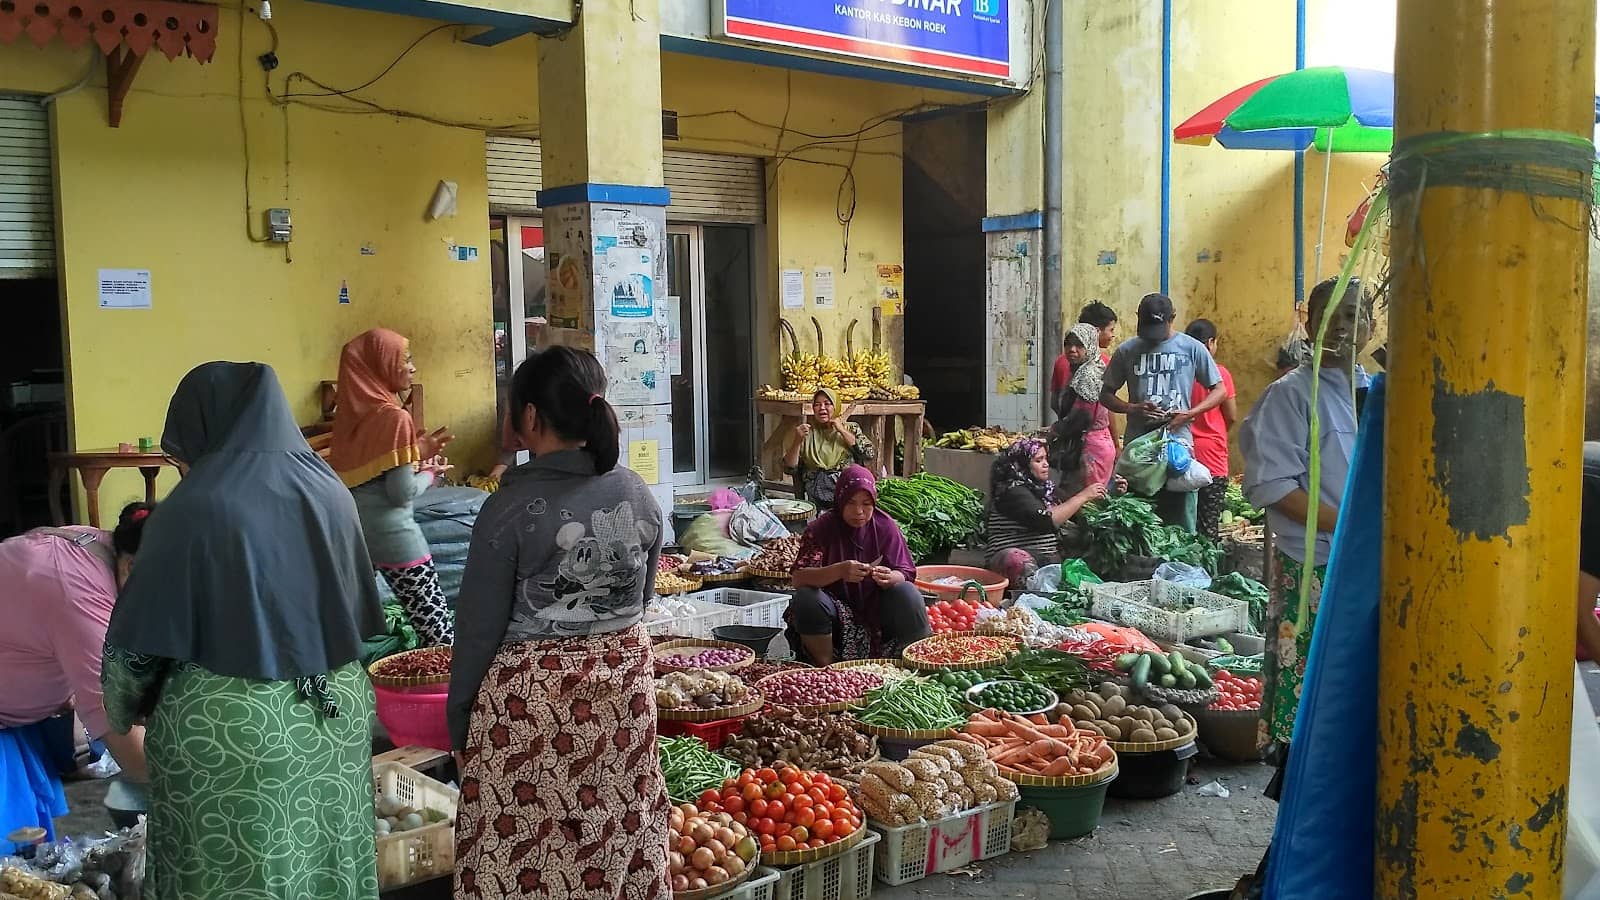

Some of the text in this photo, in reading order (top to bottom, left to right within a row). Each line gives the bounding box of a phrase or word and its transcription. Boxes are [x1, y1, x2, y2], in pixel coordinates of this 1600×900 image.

[834, 3, 947, 34] KANTOR KAS KEBON ROEK
[891, 0, 962, 17] NAR
